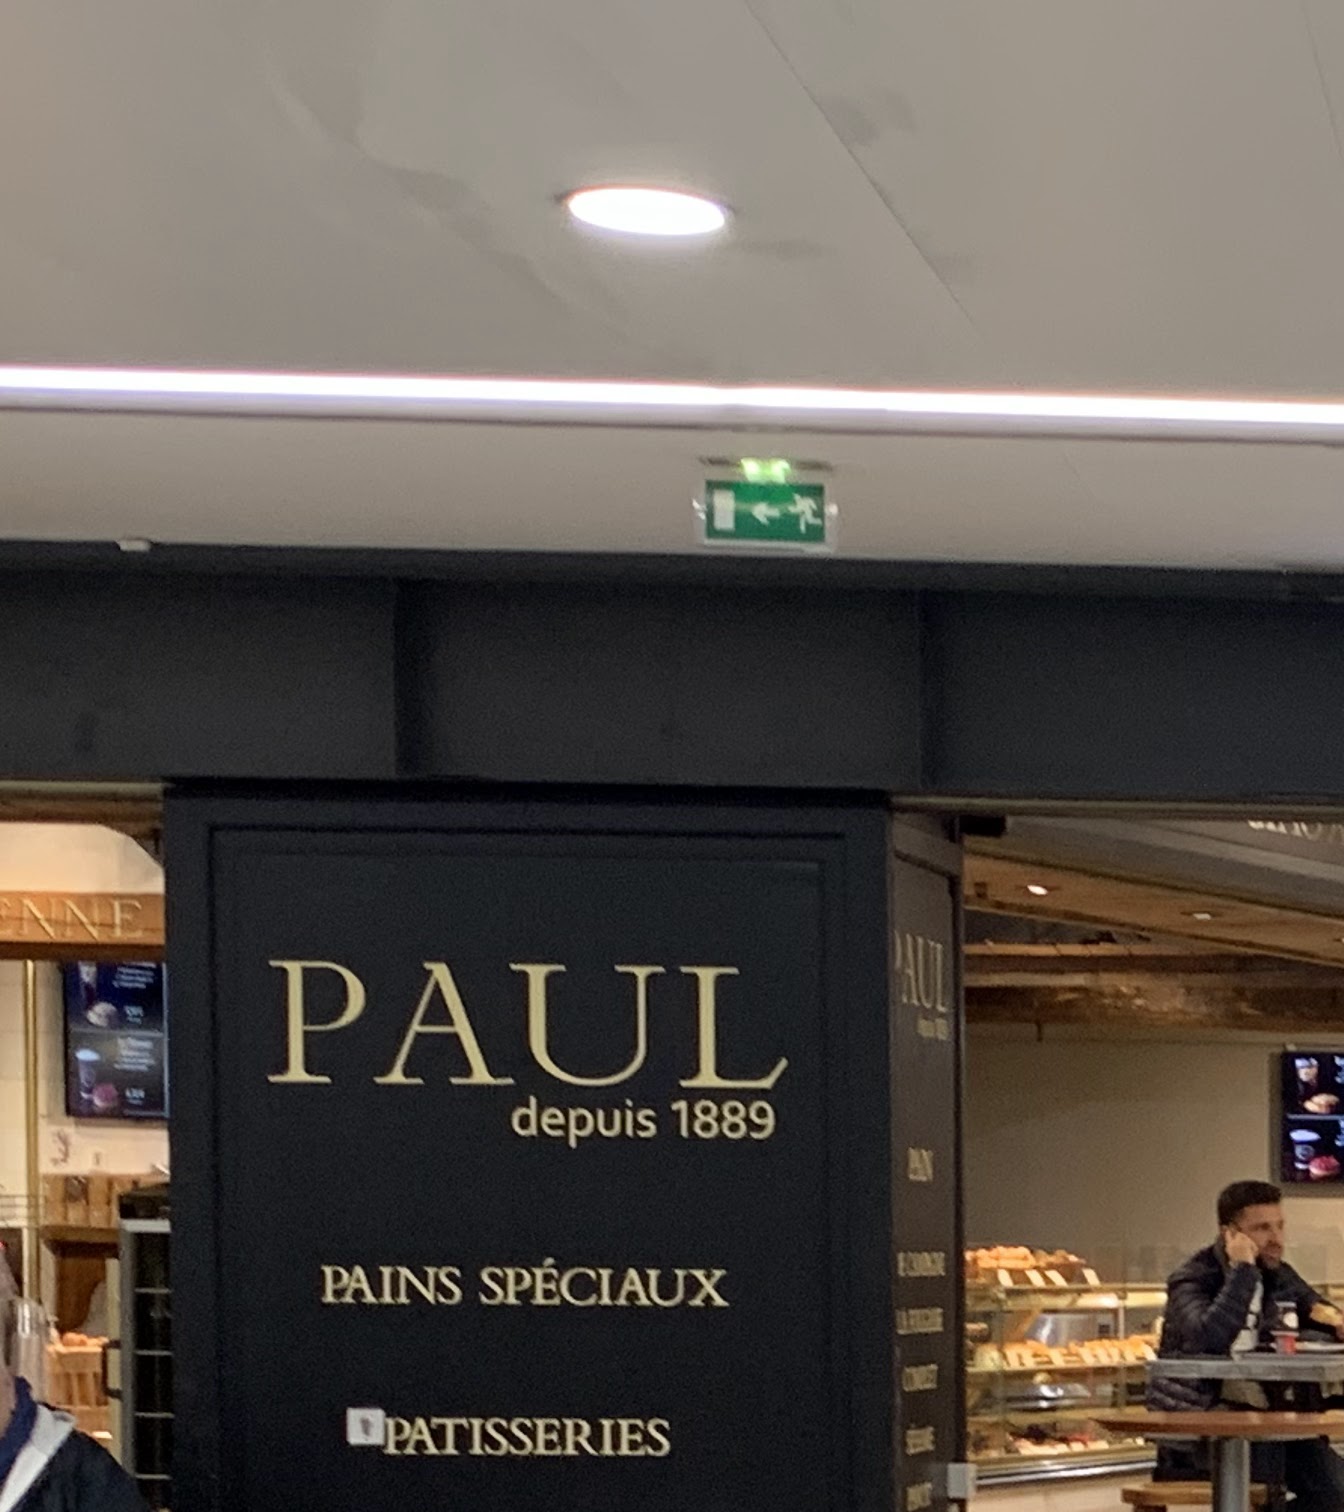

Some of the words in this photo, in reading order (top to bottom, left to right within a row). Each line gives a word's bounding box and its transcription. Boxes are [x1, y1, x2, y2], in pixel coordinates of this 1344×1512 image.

[267, 959, 789, 1090] PAUL
[511, 1096, 657, 1148] depuis
[671, 1100, 776, 1140] 1889
[320, 1264, 463, 1305] PAINS
[478, 1257, 730, 1307] SPÉCIAUX
[382, 1416, 671, 1457] PATISSERIES
